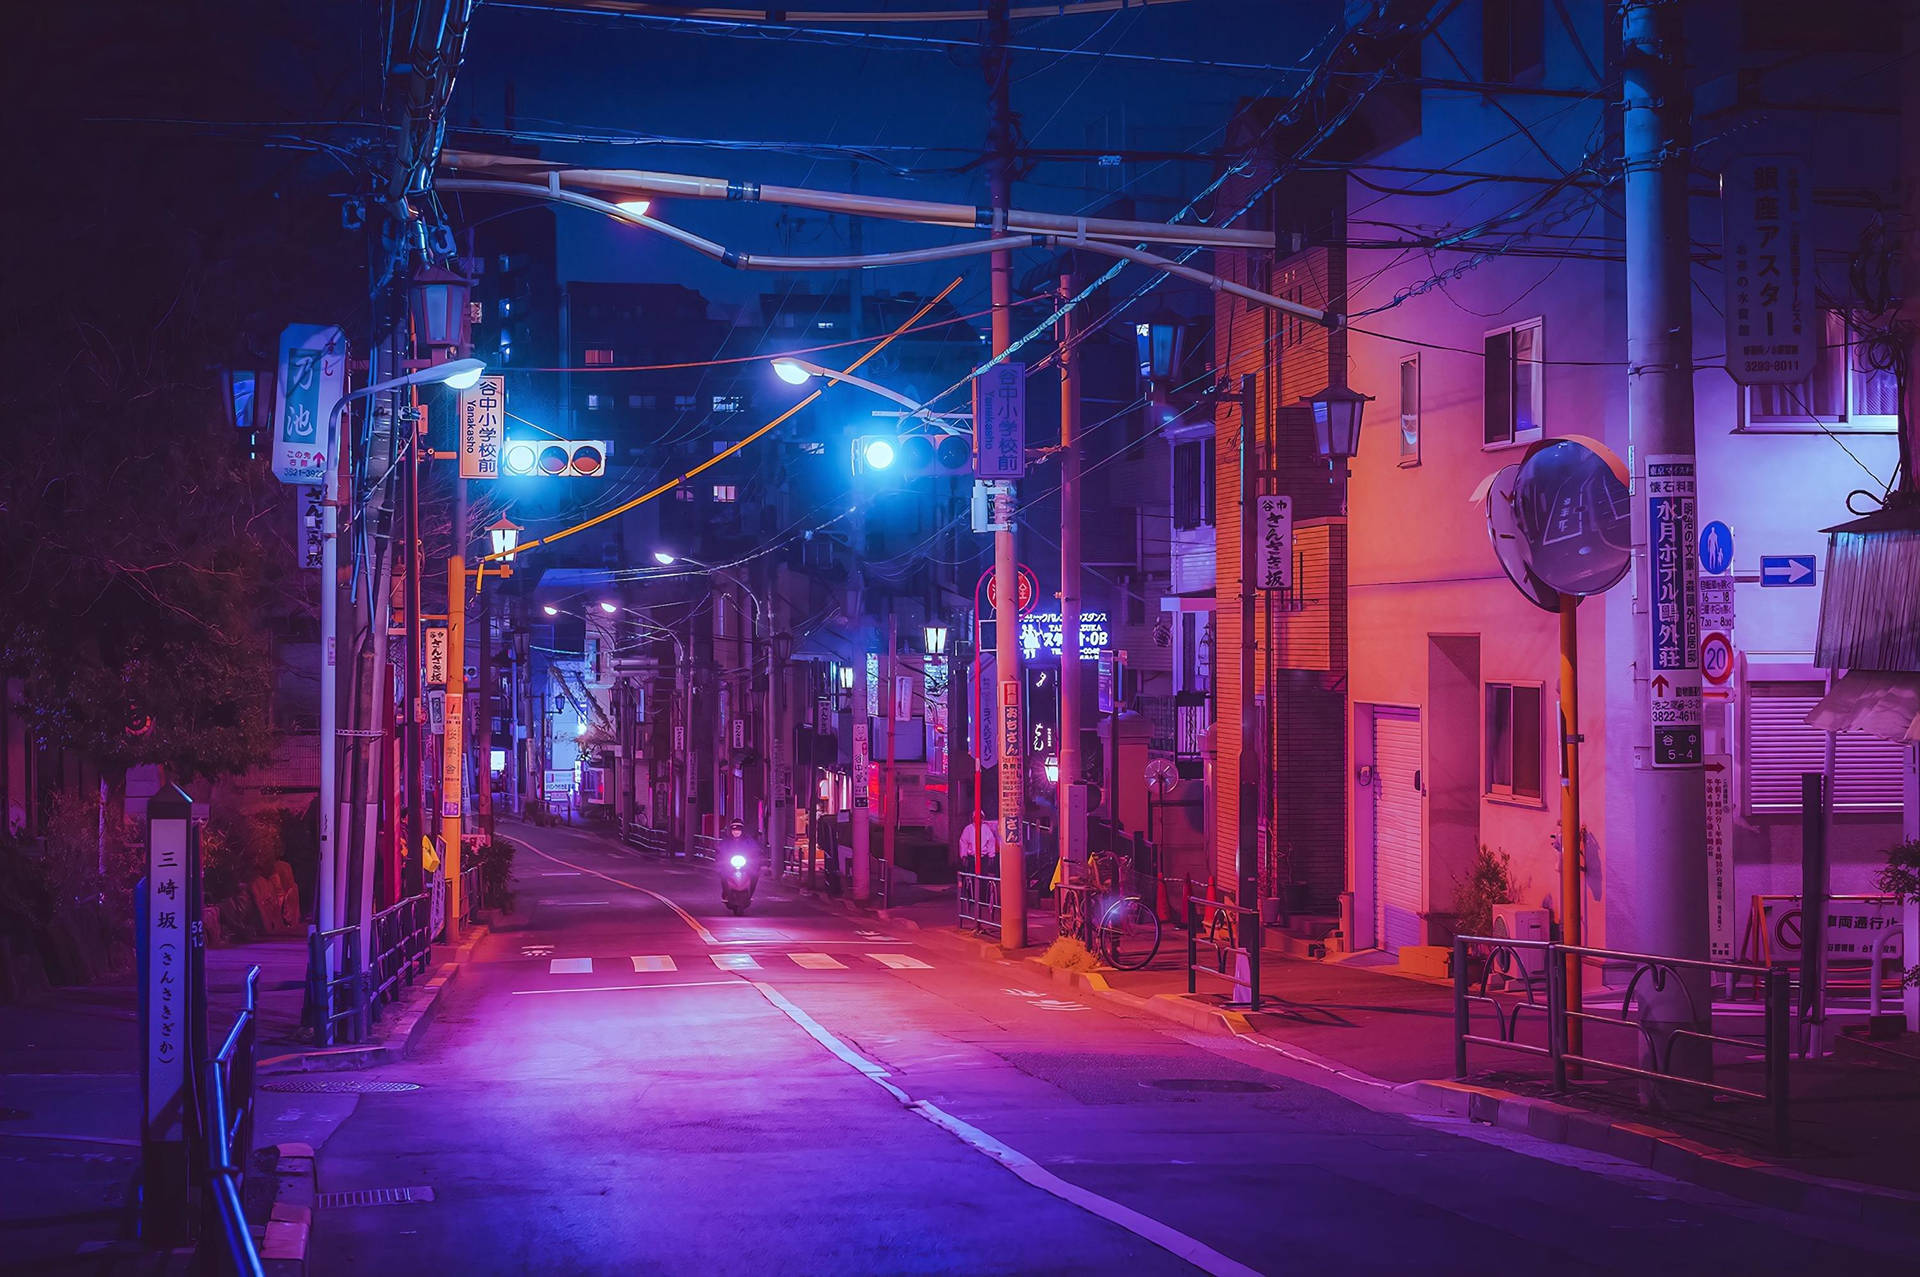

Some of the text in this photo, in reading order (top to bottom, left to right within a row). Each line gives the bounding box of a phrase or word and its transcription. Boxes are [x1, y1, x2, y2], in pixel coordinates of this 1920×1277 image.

[1754, 167, 1780, 336] 銀座アスター
[286, 355, 314, 437] 乃池
[466, 399, 477, 454] Yanakasho
[478, 381, 498, 473] 谷中小学校前
[999, 368, 1018, 471] 谷中小学校前
[1262, 500, 1288, 511] 谷中
[1650, 481, 1694, 493] 懐石料理
[1265, 512, 1285, 586] さんさき坂
[1706, 648, 1726, 670] 20
